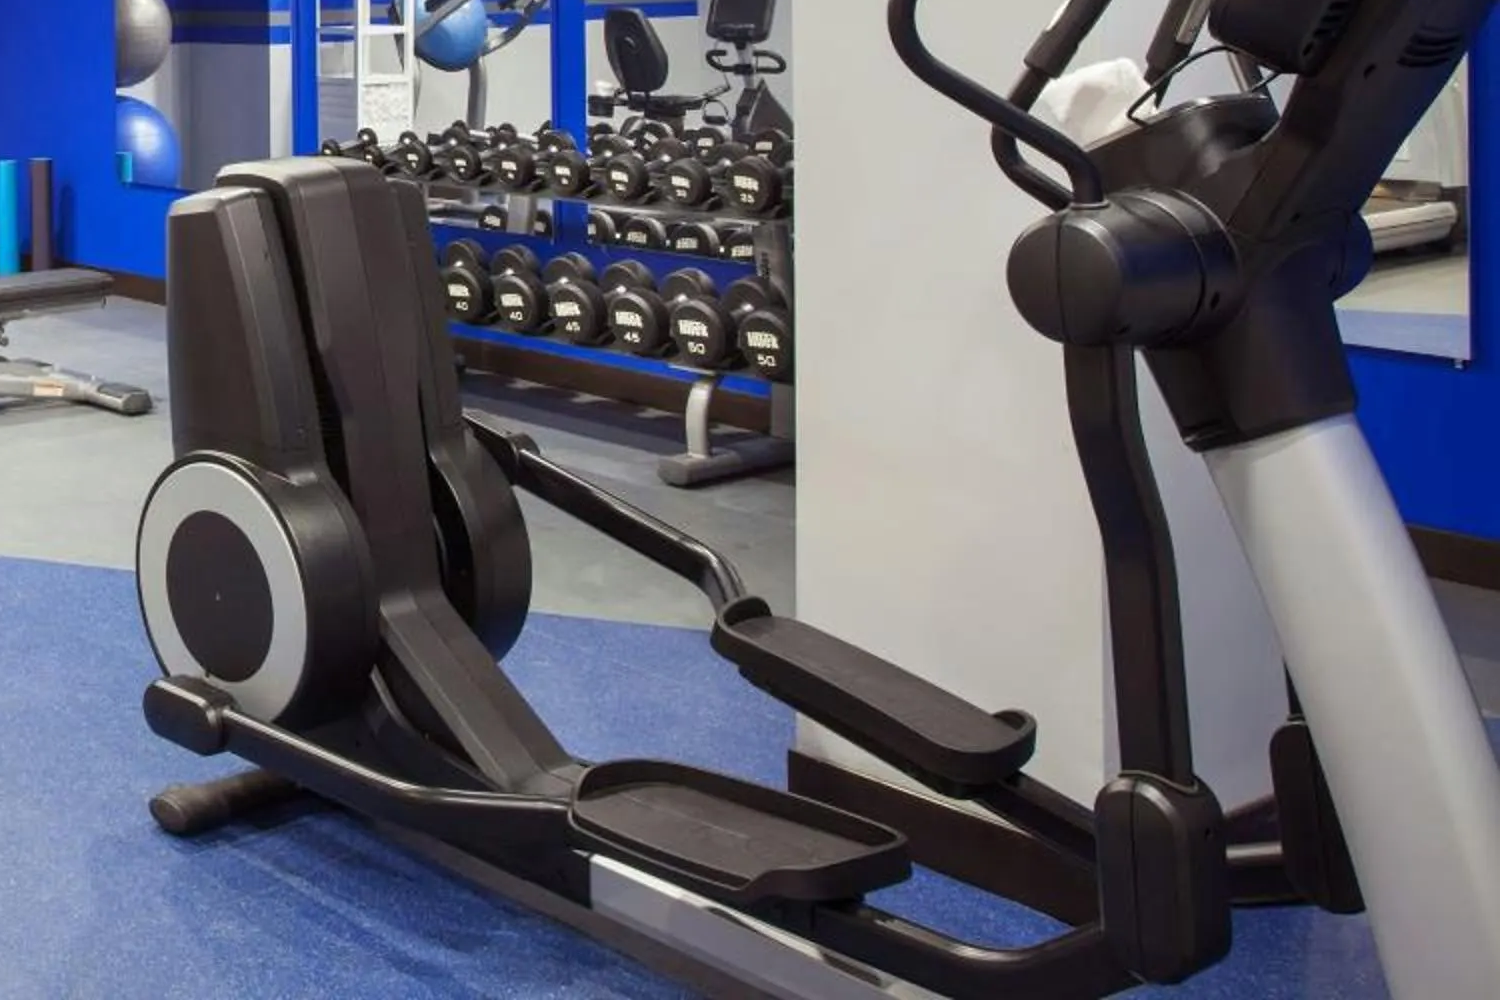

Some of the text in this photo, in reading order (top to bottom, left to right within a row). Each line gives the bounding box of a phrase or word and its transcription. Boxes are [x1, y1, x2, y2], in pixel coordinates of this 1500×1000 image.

[455, 301, 469, 311] 40
[509, 311, 523, 321] 40
[623, 331, 641, 343] 45
[756, 353, 777, 367] 50
